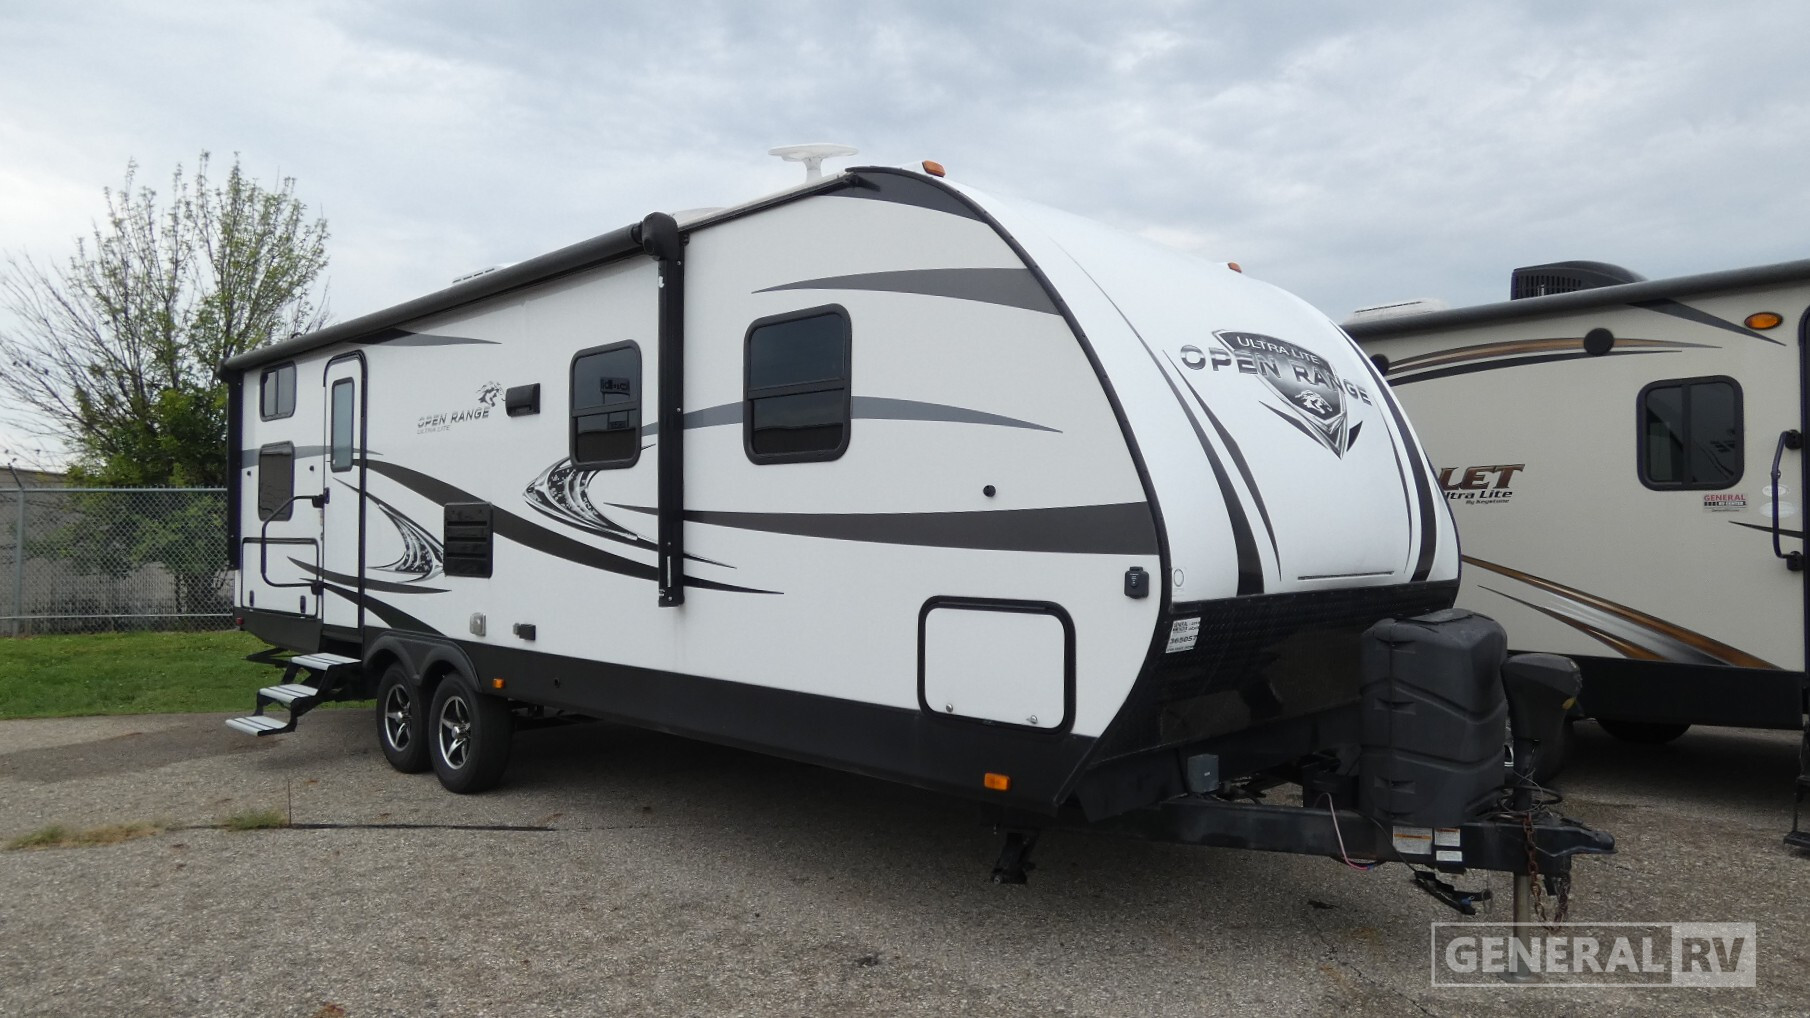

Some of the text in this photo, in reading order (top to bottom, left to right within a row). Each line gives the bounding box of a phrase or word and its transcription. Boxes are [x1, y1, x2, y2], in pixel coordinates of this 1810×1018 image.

[1237, 335, 1319, 364] ULTRA LITE
[1180, 344, 1372, 406] OPEN RANGE
[417, 407, 490, 428] OPEN RANGE
[1480, 490, 1513, 498] Lite
